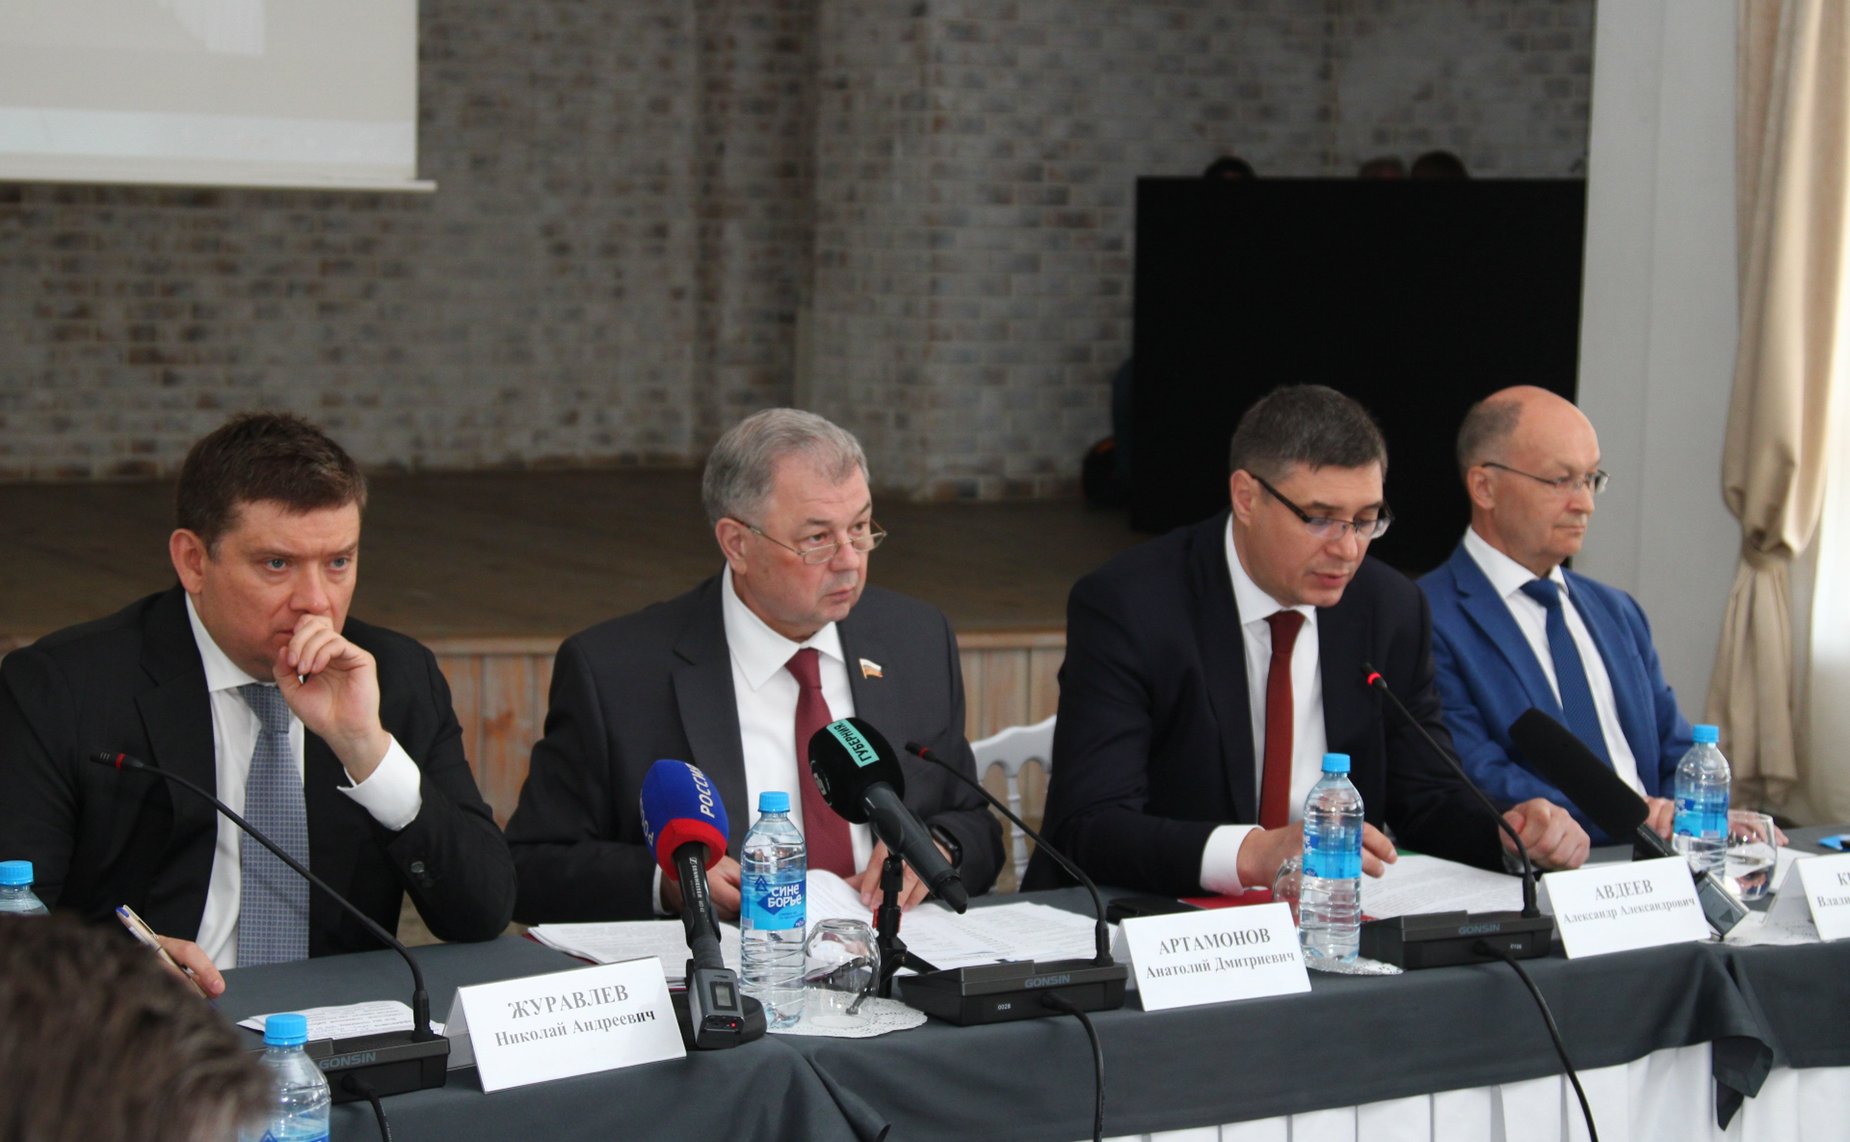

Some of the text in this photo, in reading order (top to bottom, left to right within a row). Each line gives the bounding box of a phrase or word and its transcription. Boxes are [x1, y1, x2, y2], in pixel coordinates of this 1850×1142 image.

[834, 722, 872, 762] ГУБЕРНИЯ
[1595, 879, 1653, 900] АВДЕЕВ
[1563, 897, 1696, 923] Александр Александрович
[1159, 929, 1271, 955] АРТАМОНОВ
[1459, 923, 1501, 935] GONSIN
[1146, 951, 1296, 980] Анатолий Дмитриевич
[1025, 974, 1071, 988] GONSIN
[508, 984, 628, 1019] ЖУРАВЛЕВ
[495, 1010, 656, 1046] Николай Андреевич
[319, 1053, 376, 1070] GONSIN
